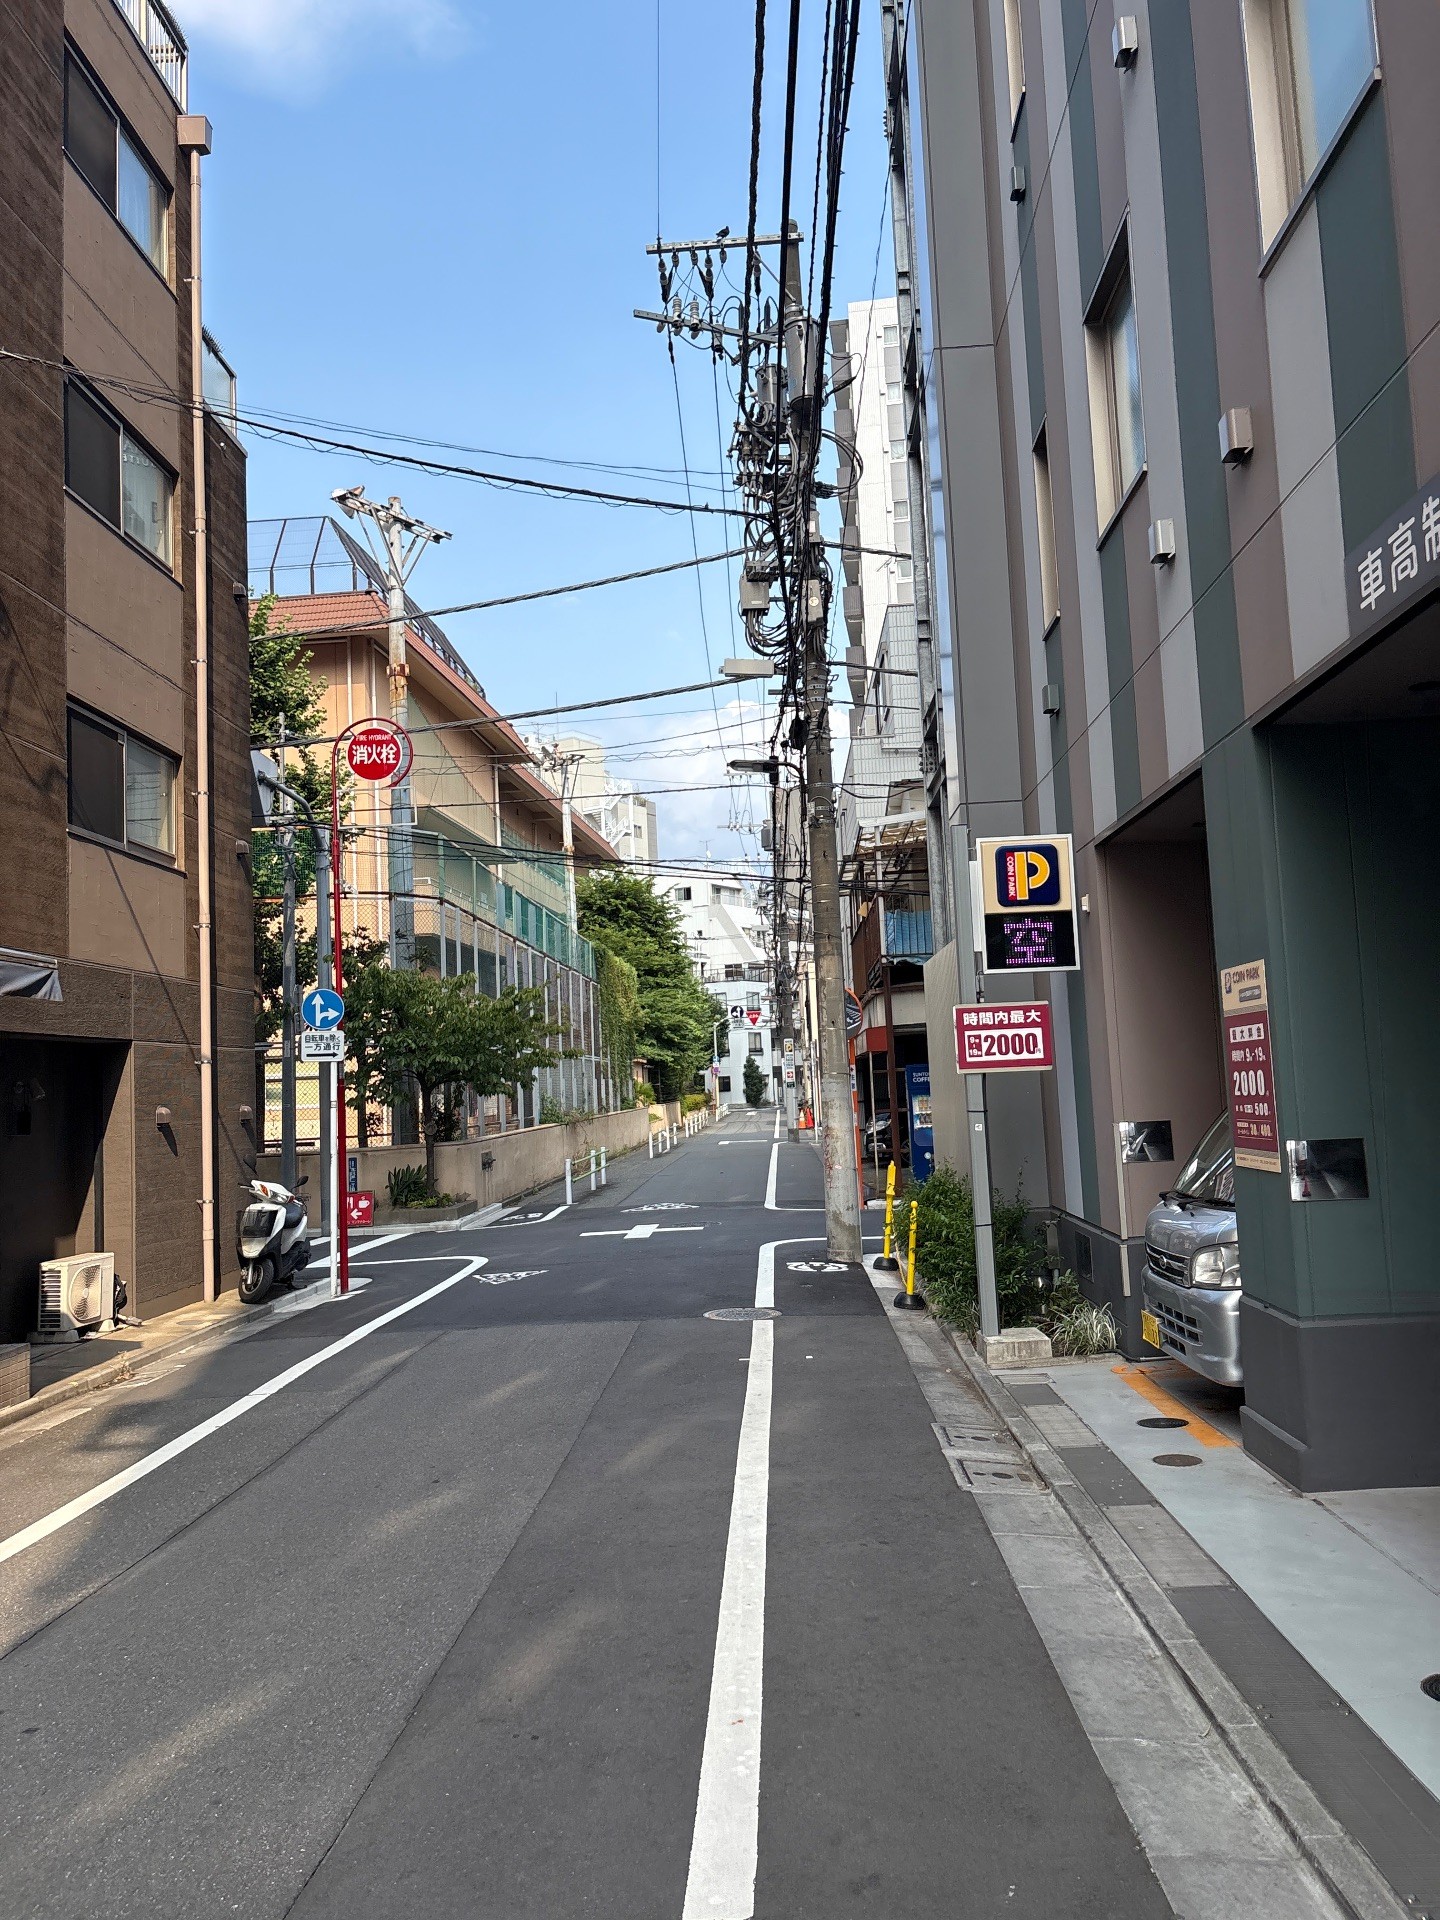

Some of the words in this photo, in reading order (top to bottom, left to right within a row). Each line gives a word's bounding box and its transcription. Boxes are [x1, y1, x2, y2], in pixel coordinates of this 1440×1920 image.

[352, 743, 397, 765] 消火栓
[1006, 856, 1014, 876] COIN
[1008, 876, 1016, 897] PARK
[1003, 918, 1055, 964] 空
[1246, 966, 1260, 981] PARK
[962, 1009, 1042, 1026] 時間内最大
[305, 1034, 341, 1043] 自転車を除く
[305, 1043, 341, 1051] 一方通行
